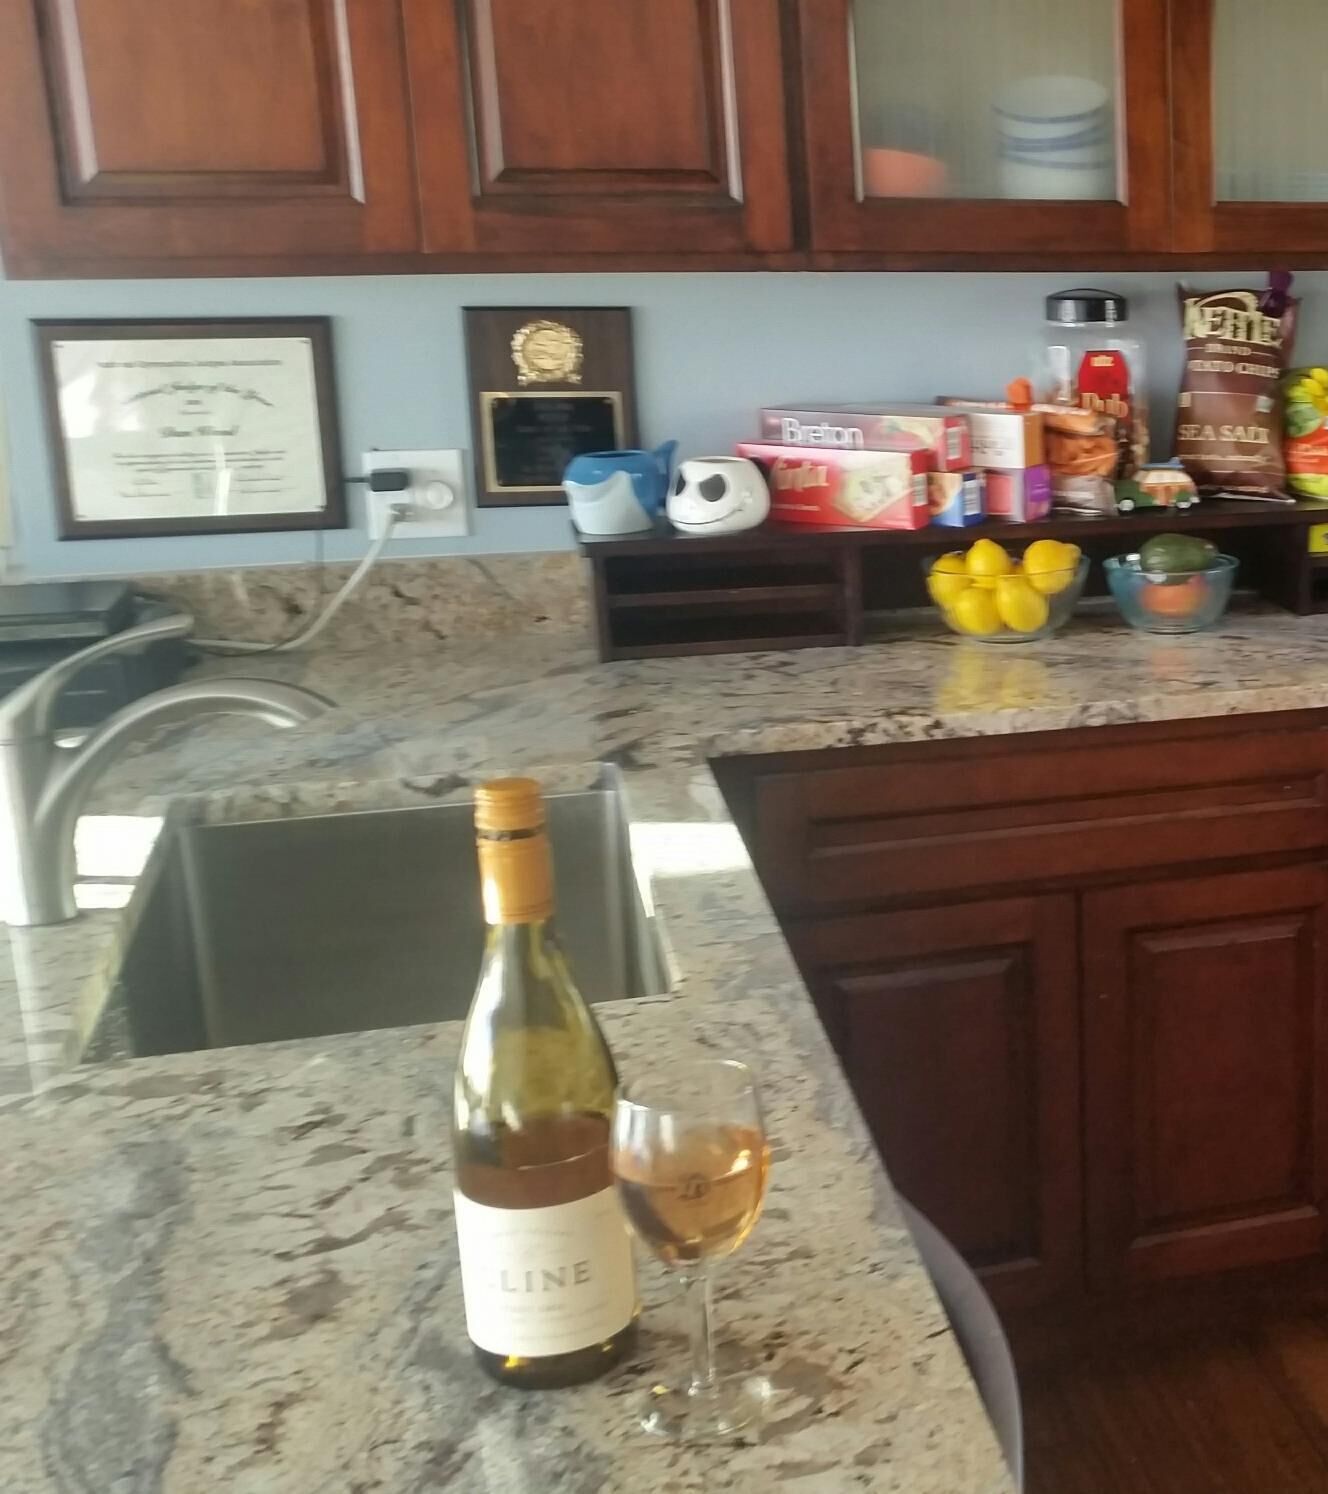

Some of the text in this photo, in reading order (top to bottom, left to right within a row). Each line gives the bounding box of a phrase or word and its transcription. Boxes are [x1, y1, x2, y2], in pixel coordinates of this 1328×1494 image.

[781, 417, 864, 449] Breton
[1178, 424, 1270, 444] SEA SALT
